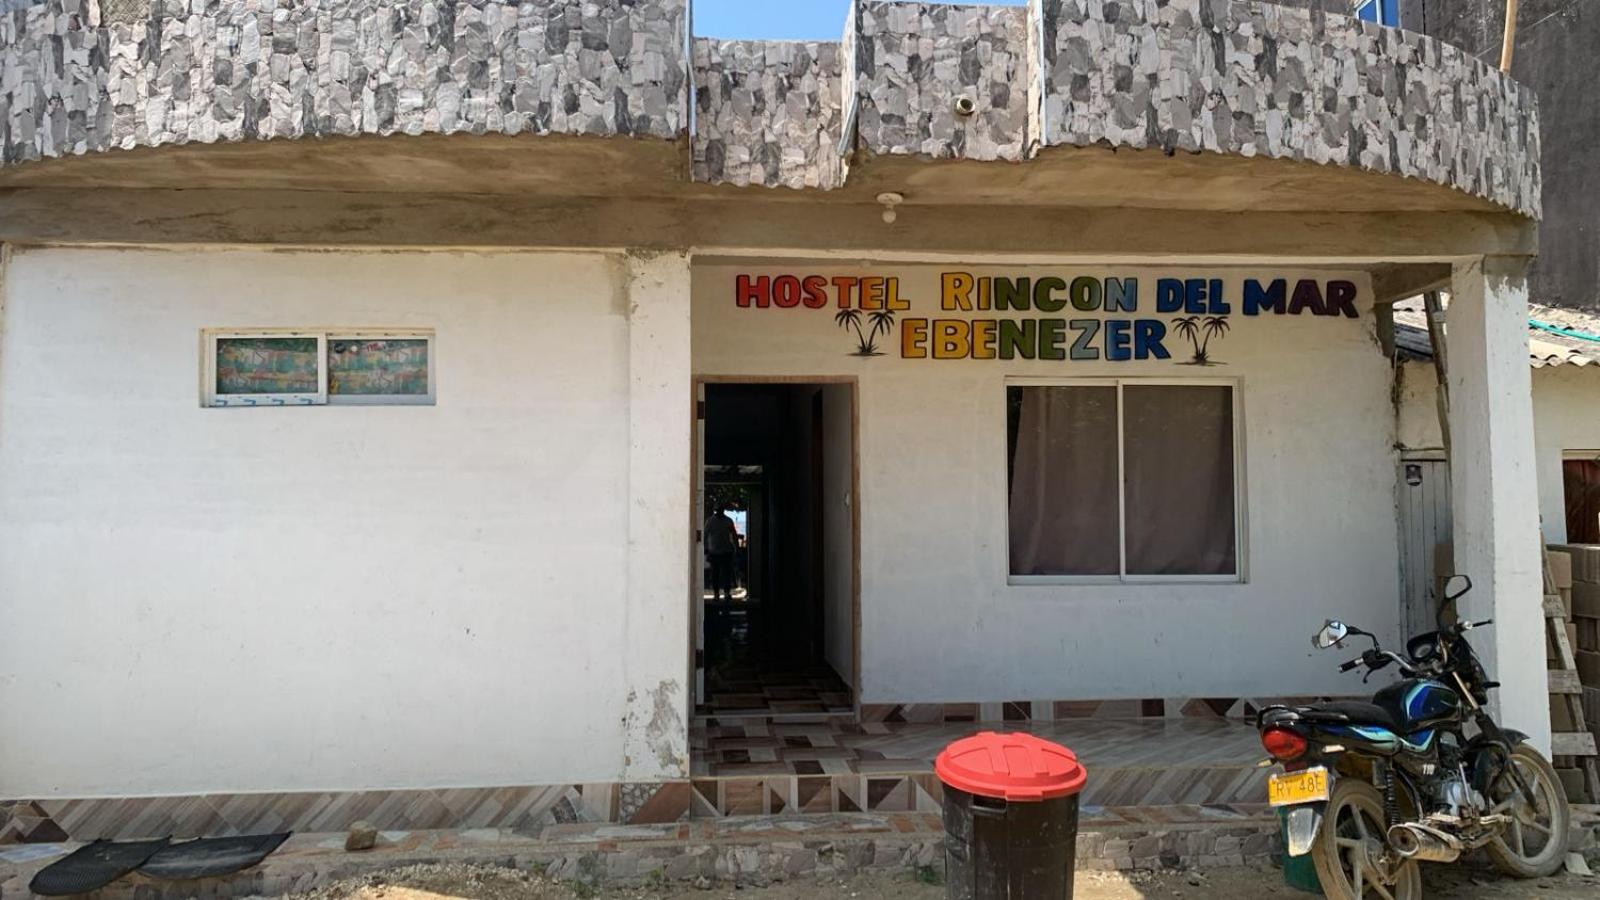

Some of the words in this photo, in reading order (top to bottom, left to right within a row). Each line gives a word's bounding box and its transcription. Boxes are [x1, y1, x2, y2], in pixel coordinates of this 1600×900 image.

[736, 275, 910, 310] HOSTEL
[941, 272, 1138, 312] RINCON
[1156, 278, 1231, 314] DEL
[1242, 279, 1359, 318] MAR
[901, 318, 1172, 361] EBENEZER
